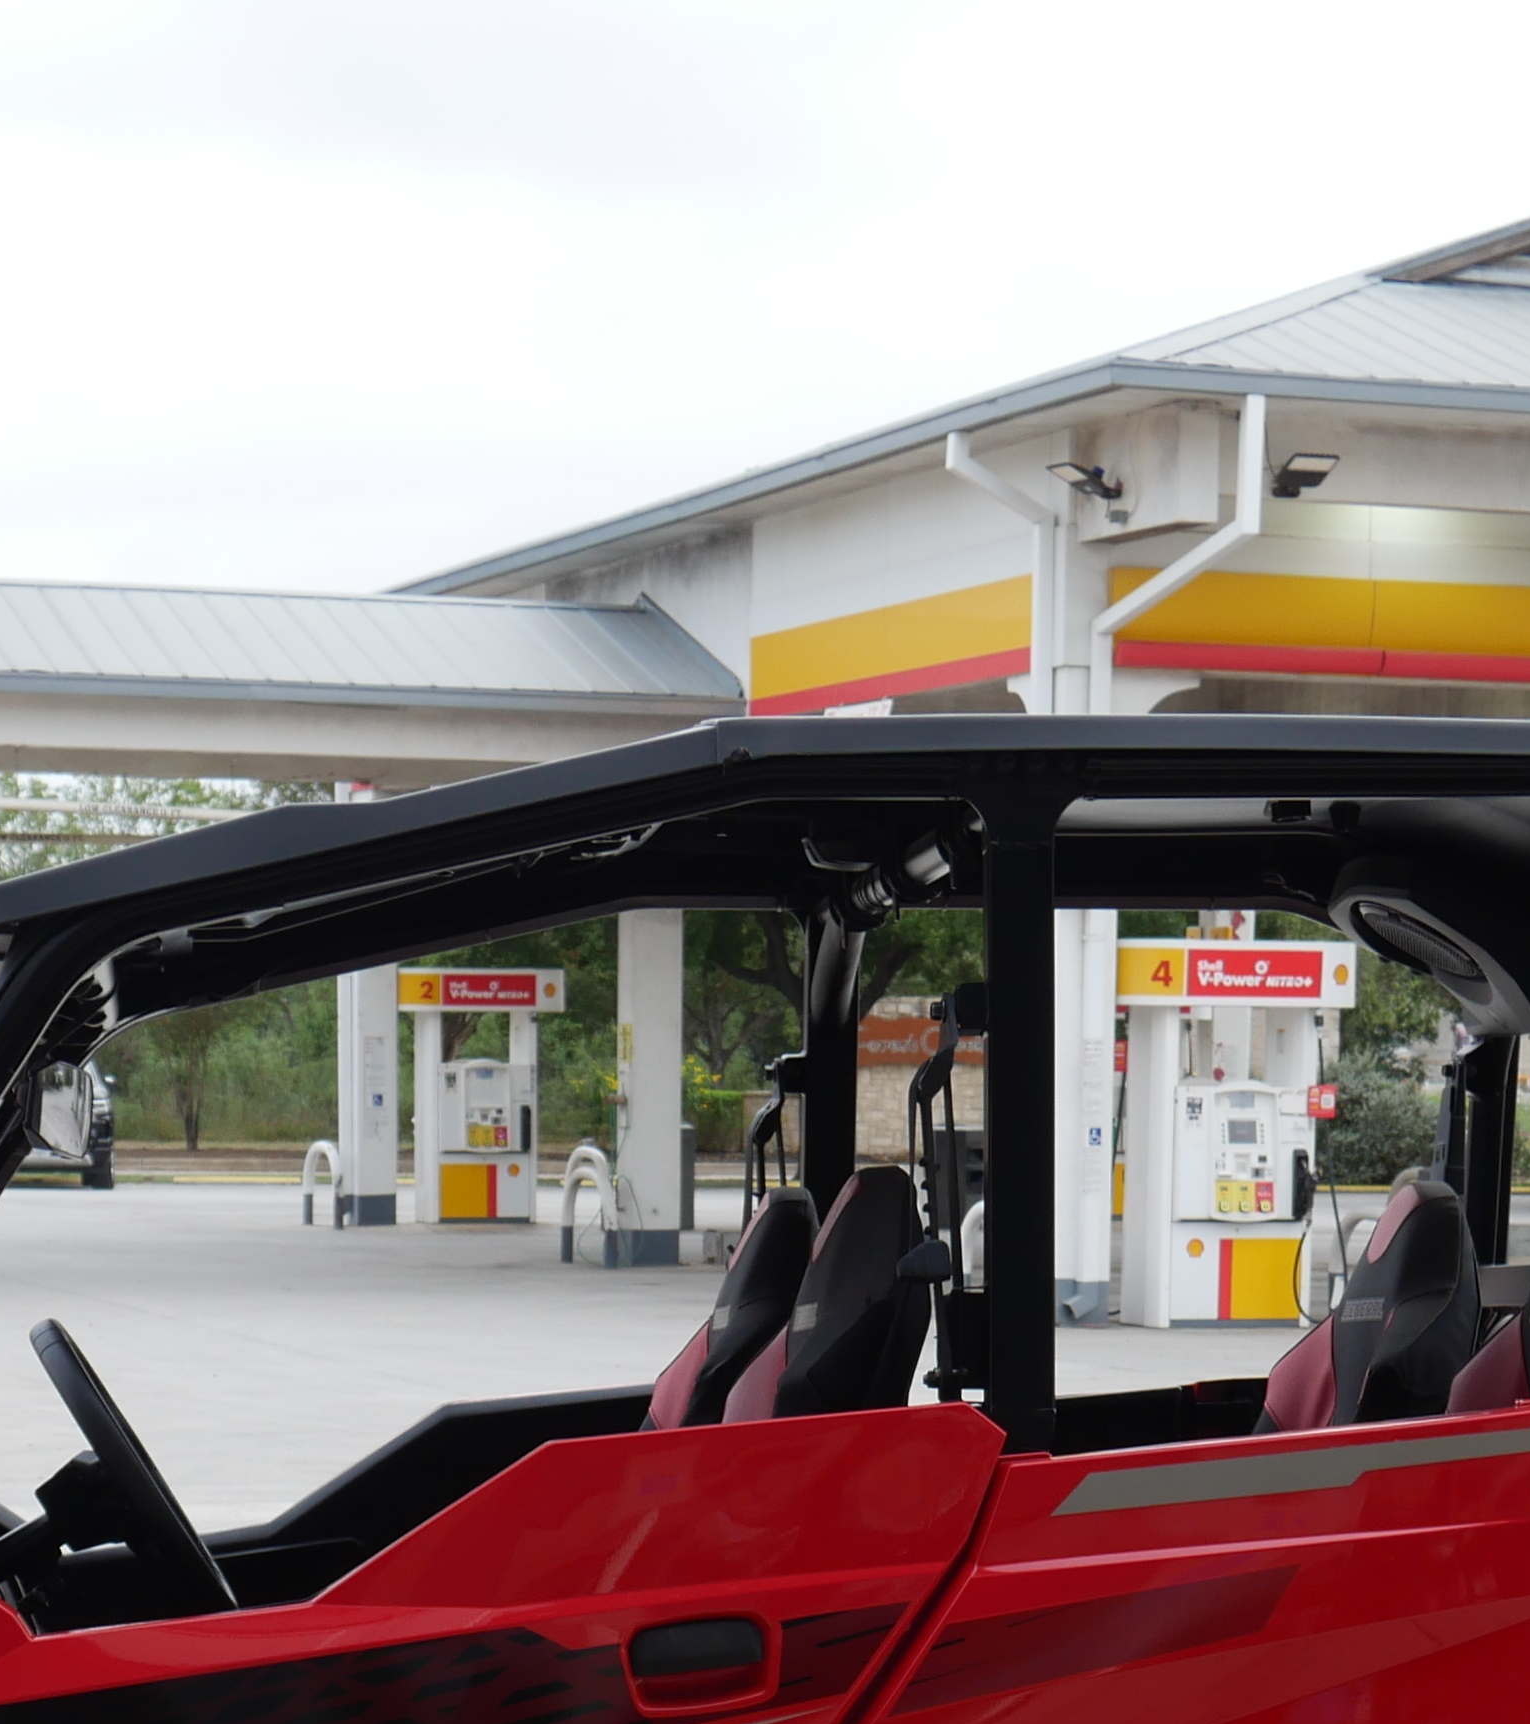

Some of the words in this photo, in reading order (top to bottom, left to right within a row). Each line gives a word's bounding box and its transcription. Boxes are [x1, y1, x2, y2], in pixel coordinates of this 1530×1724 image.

[1151, 961, 1173, 987] 4
[1197, 960, 1223, 972] Shell
[1198, 971, 1263, 987] V-Power
[420, 981, 433, 999] 2
[450, 989, 494, 999] V-Power
